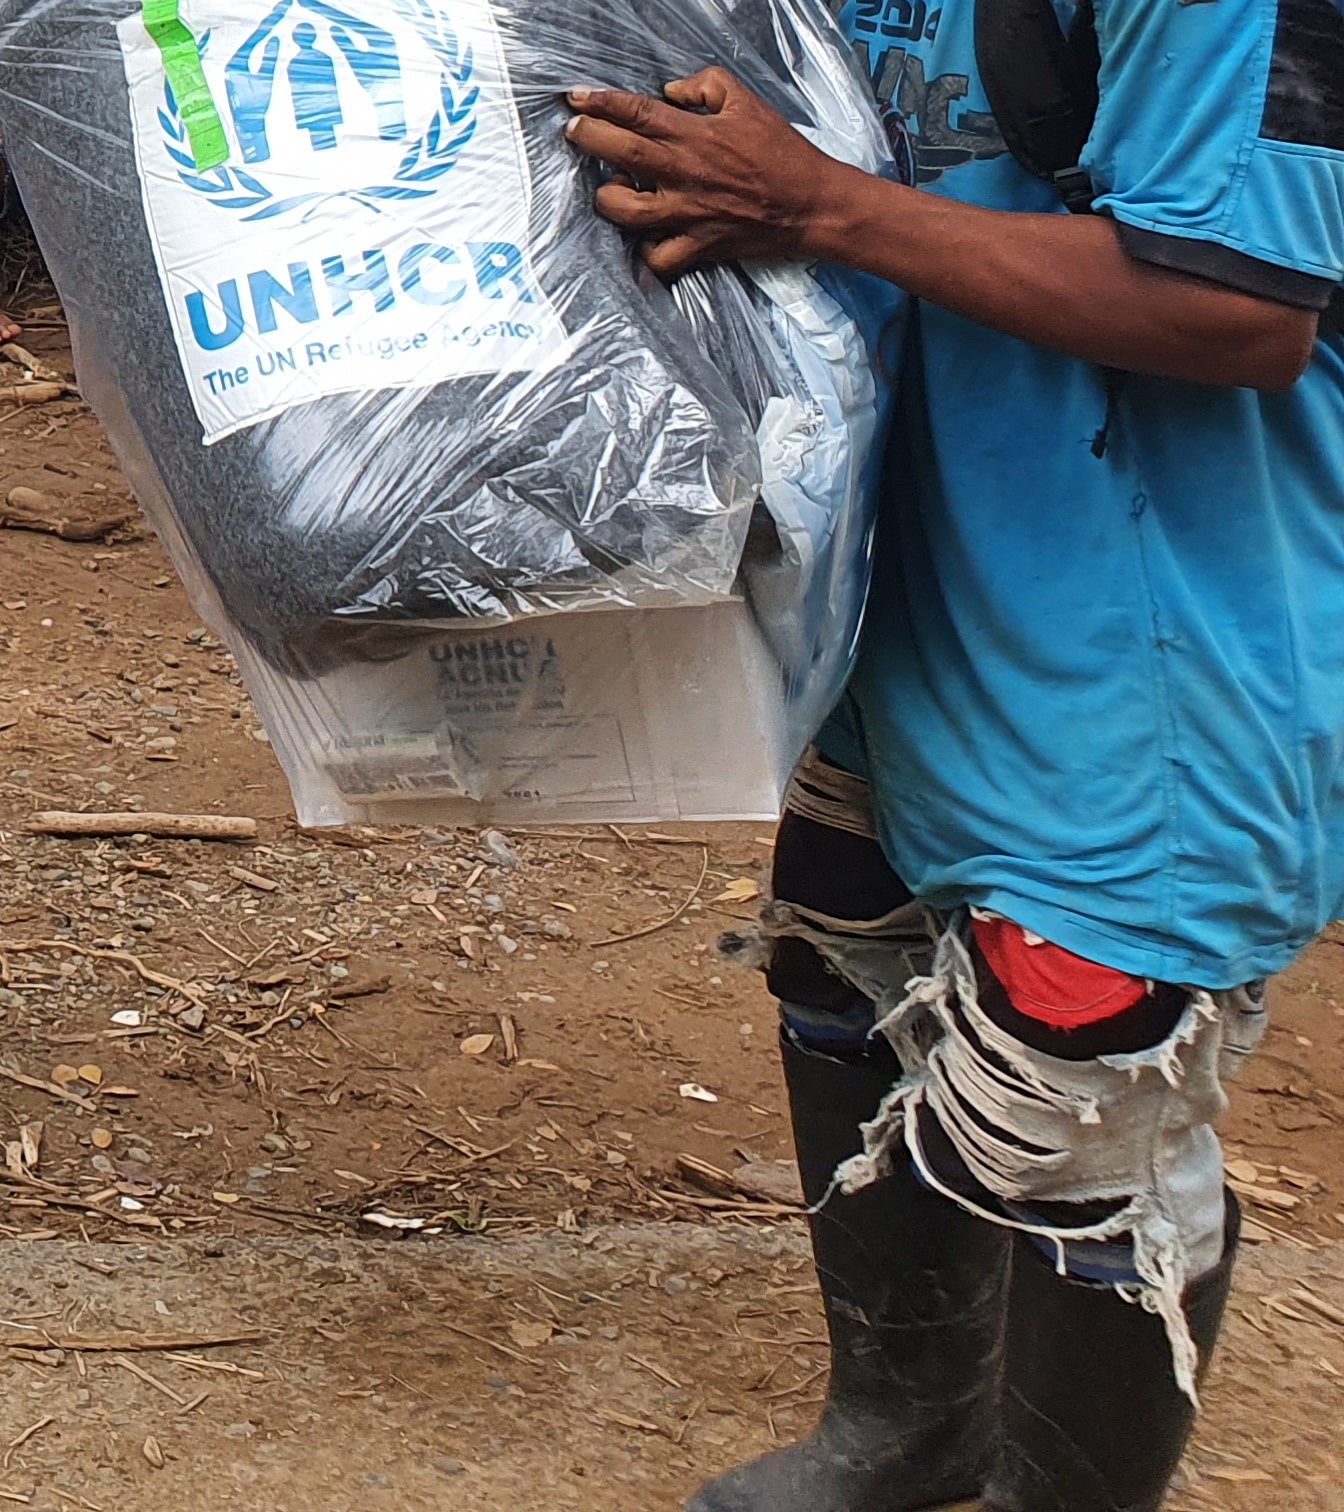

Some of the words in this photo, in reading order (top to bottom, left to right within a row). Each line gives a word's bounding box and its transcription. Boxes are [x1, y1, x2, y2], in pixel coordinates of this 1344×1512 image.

[185, 241, 536, 351] UNHCR
[203, 364, 249, 396] The
[256, 347, 298, 378] UN
[306, 331, 429, 367] Refugee
